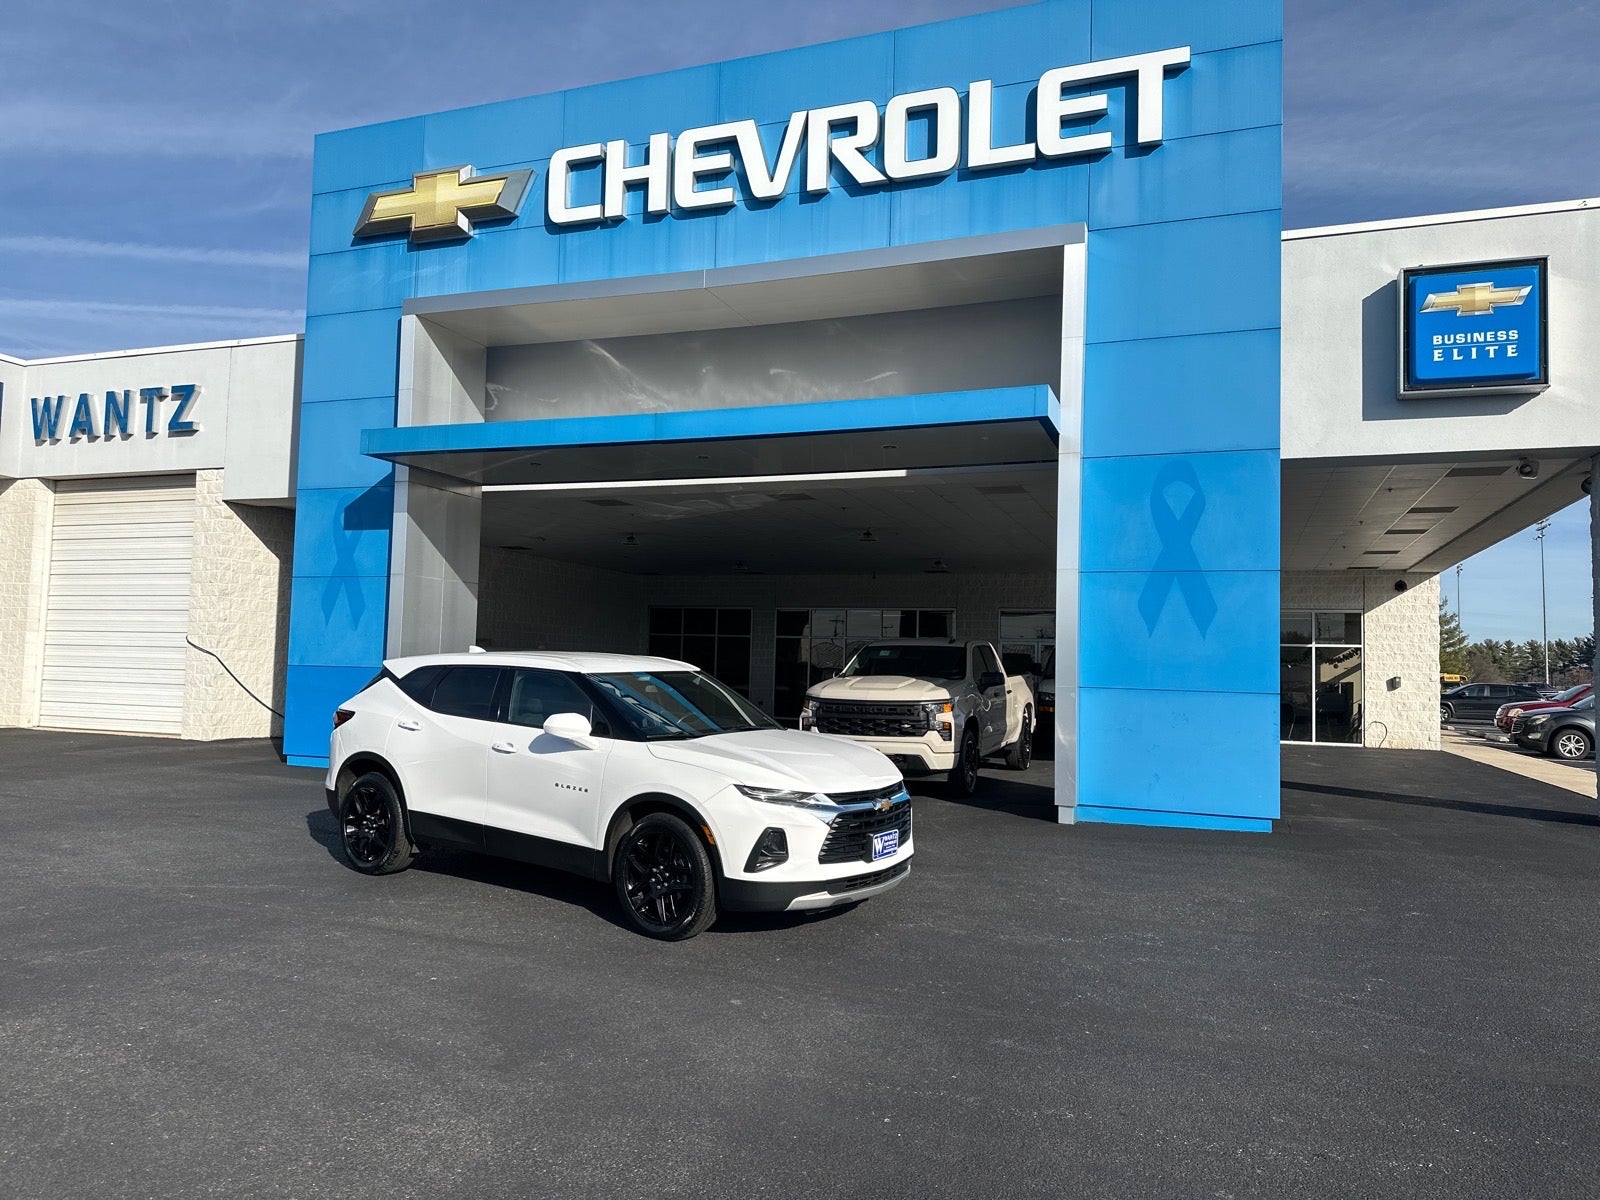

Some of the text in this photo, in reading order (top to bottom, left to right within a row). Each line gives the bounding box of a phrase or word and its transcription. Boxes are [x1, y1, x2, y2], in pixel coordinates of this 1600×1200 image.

[546, 46, 1191, 226] CHEVROLET
[1433, 330, 1518, 344] BUSINESS
[1433, 345, 1518, 361] ELITE
[31, 384, 201, 446] WANTZ
